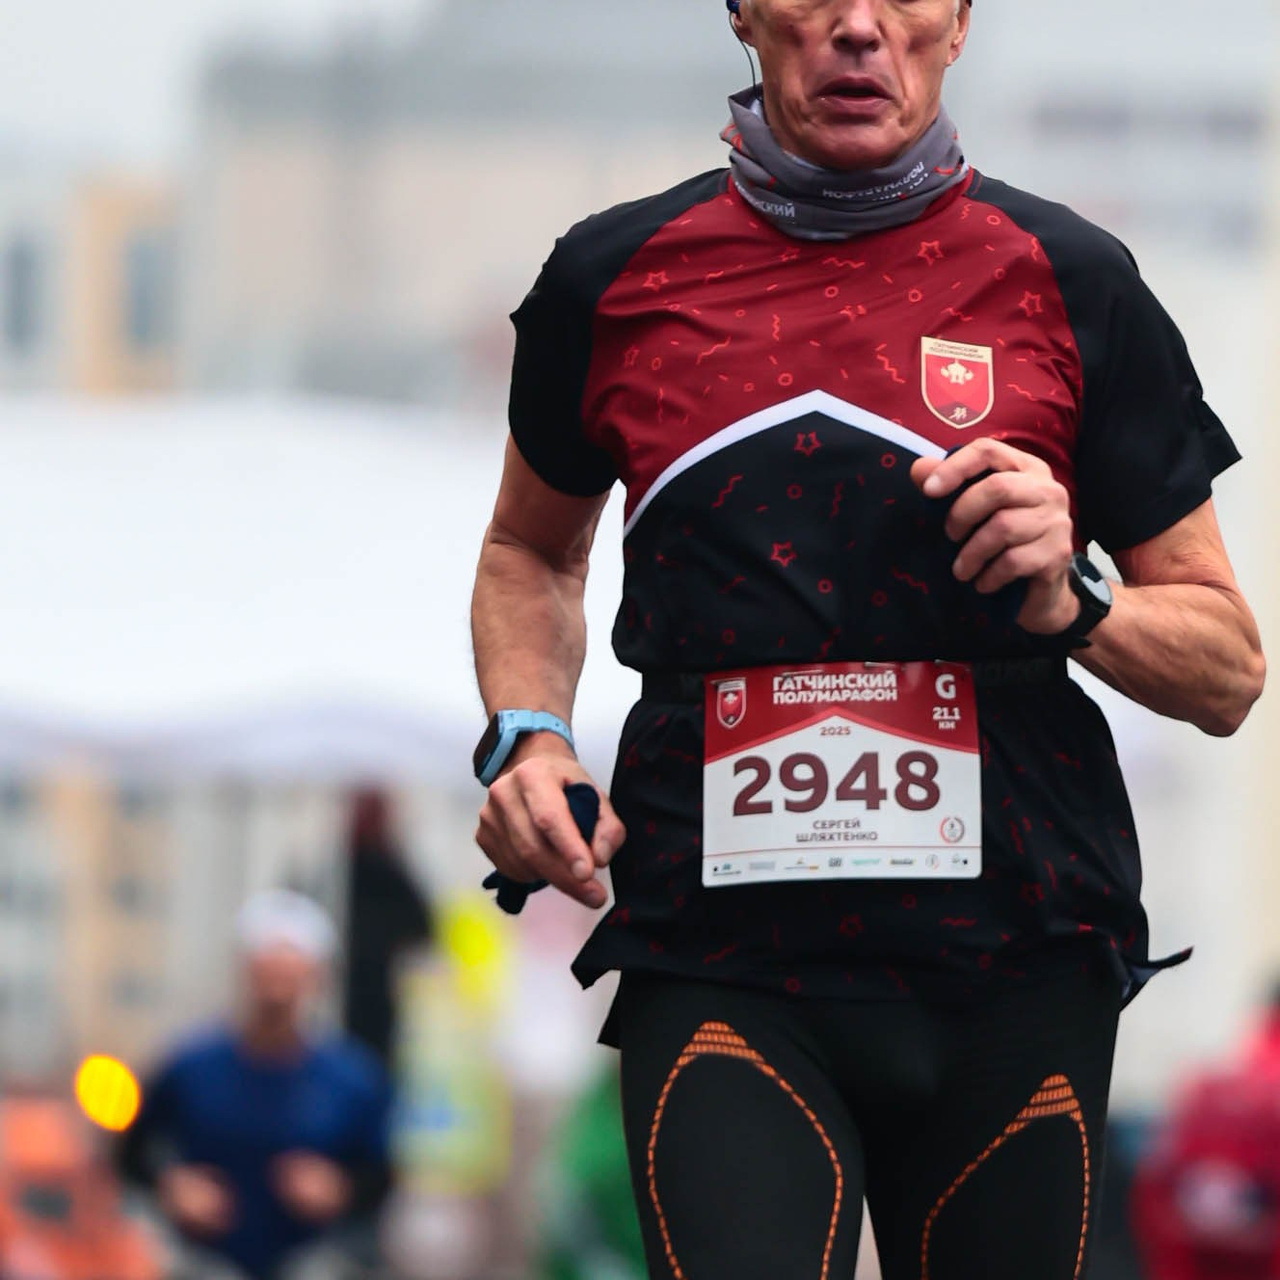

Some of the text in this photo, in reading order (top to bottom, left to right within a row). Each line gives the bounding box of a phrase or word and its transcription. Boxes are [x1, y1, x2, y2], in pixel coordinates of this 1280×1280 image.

[772, 670, 898, 691] ГАТЧИНСКИЙ
[935, 673, 957, 700] G
[772, 689, 898, 705] ПОЛУМАРАФОН
[932, 706, 962, 721] 21.1
[820, 726, 852, 737] 2025
[732, 750, 941, 817] 2948
[812, 817, 862, 830] СЕРГЕЙ
[796, 831, 879, 843] ШЛЯХТЕНКО
